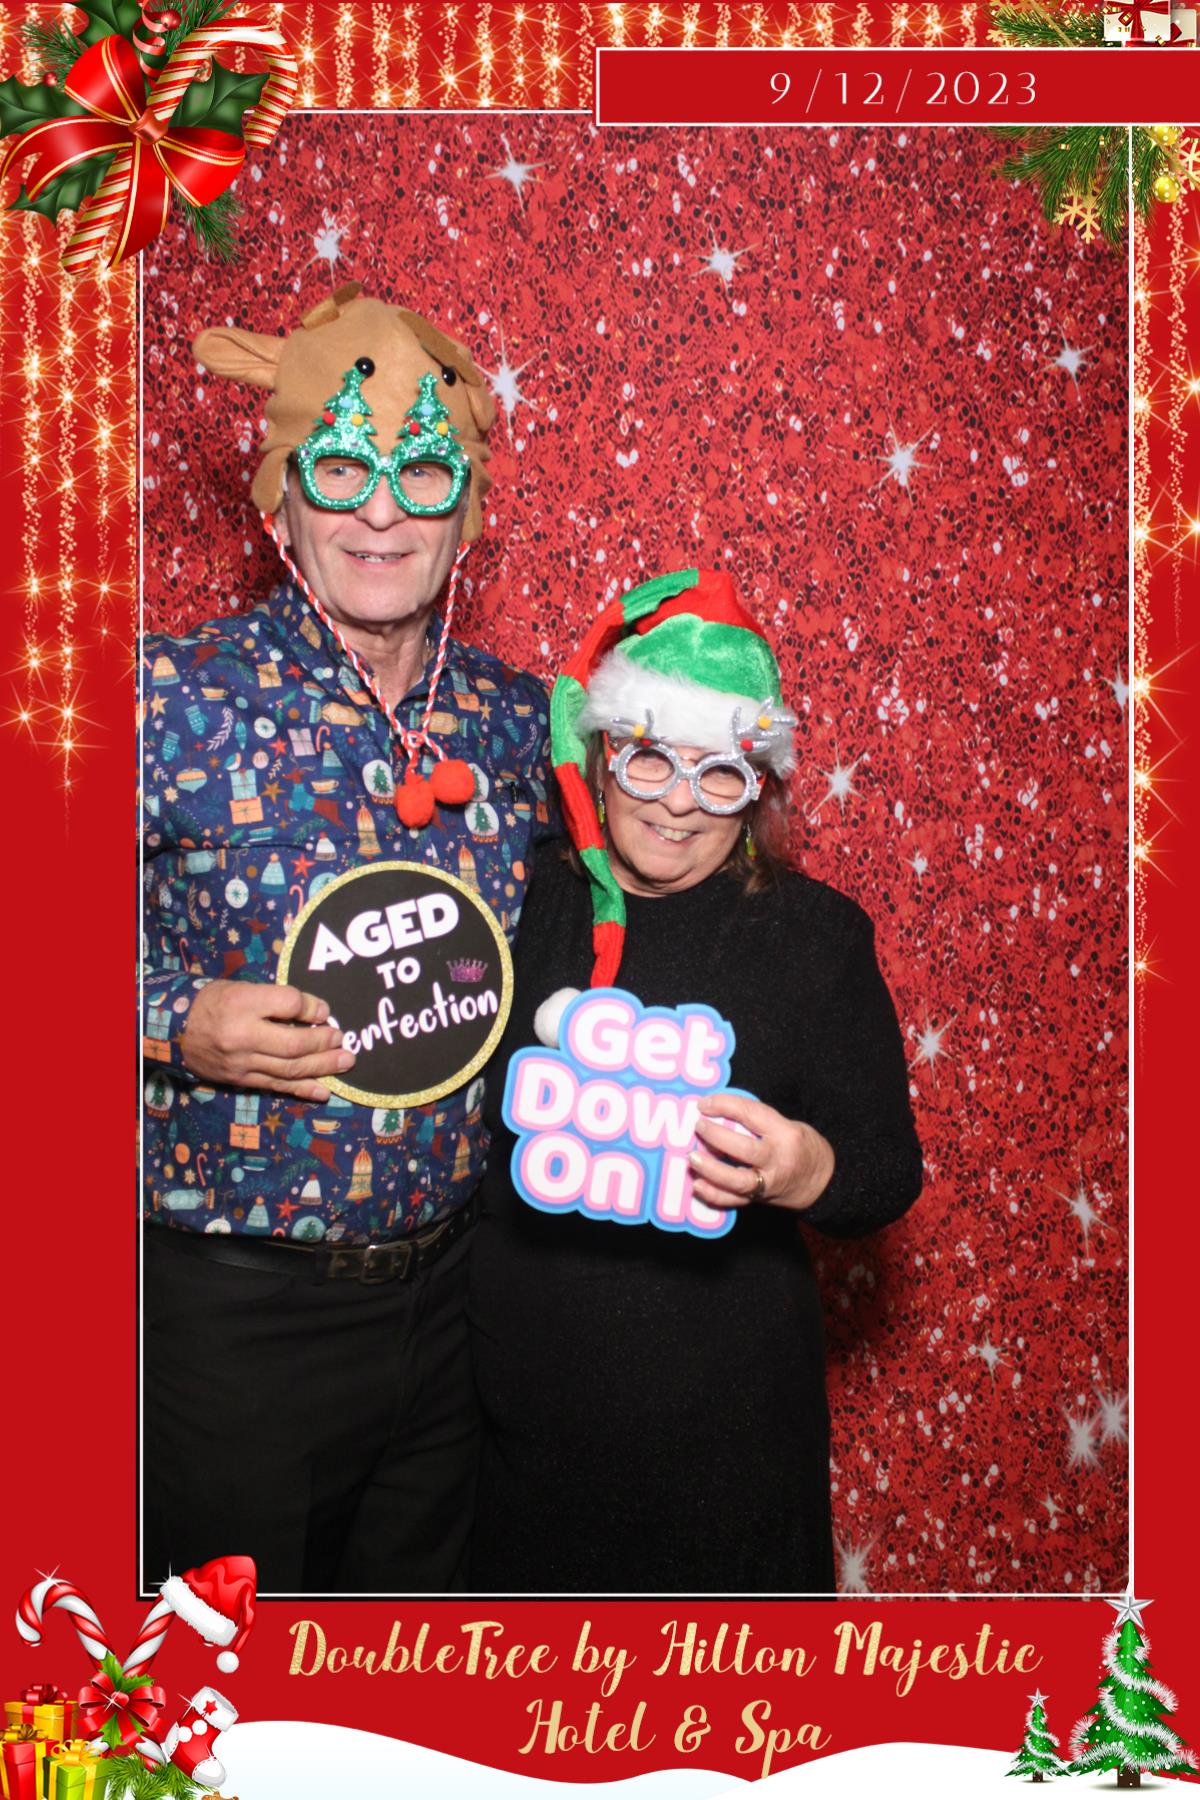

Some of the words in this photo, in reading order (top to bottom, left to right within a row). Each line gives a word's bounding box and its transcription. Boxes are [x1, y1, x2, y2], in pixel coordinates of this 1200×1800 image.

[308, 893, 459, 971] AGED
[376, 957, 421, 990] TO
[321, 981, 499, 1055] erfection
[574, 1005, 721, 1081] Get
[525, 1136, 640, 1216] On
